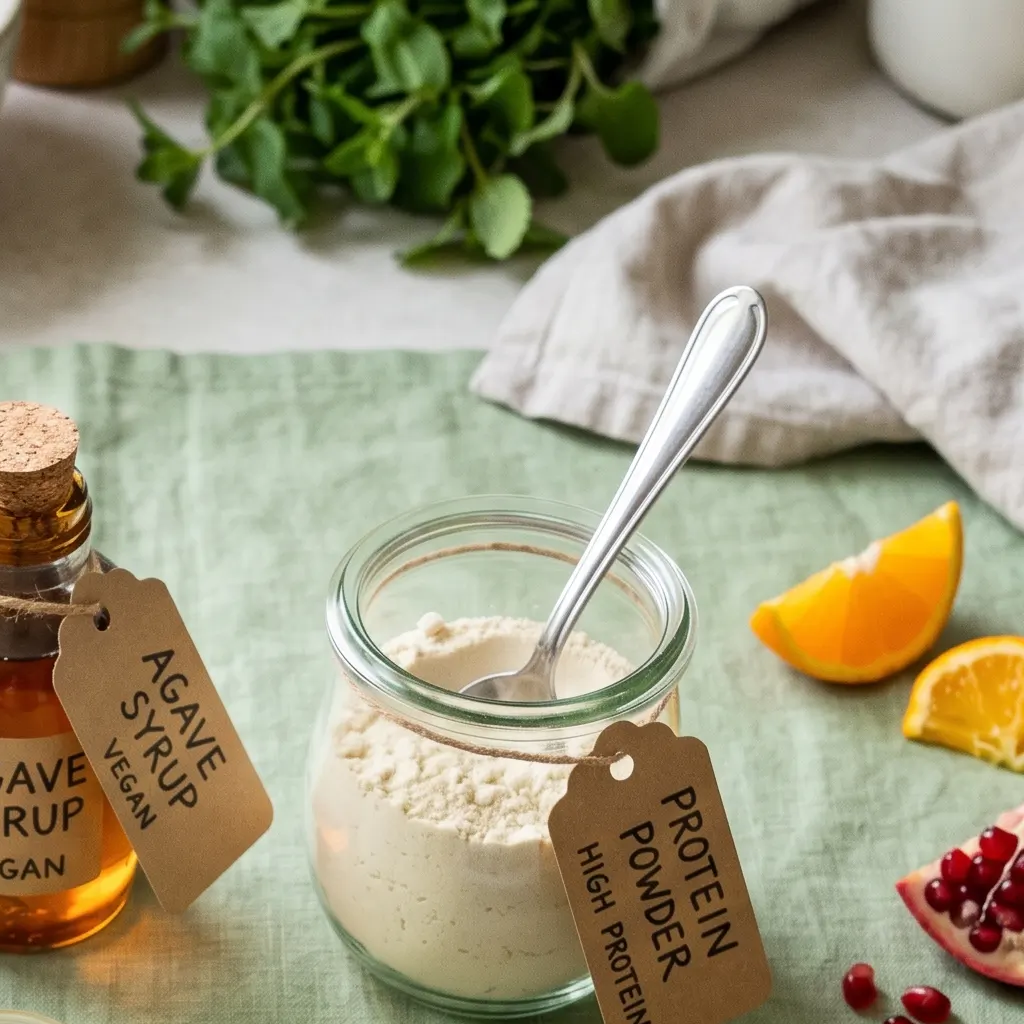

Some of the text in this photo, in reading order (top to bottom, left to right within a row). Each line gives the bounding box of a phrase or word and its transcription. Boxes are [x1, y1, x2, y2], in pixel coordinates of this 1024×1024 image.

[120, 690, 198, 809] SYRUP
[142, 648, 226, 781] AGAVE
[103, 738, 157, 831] VEGAN
[577, 841, 616, 914] HIGH
[619, 820, 691, 982] POWDER
[661, 786, 739, 958] PROTEIN
